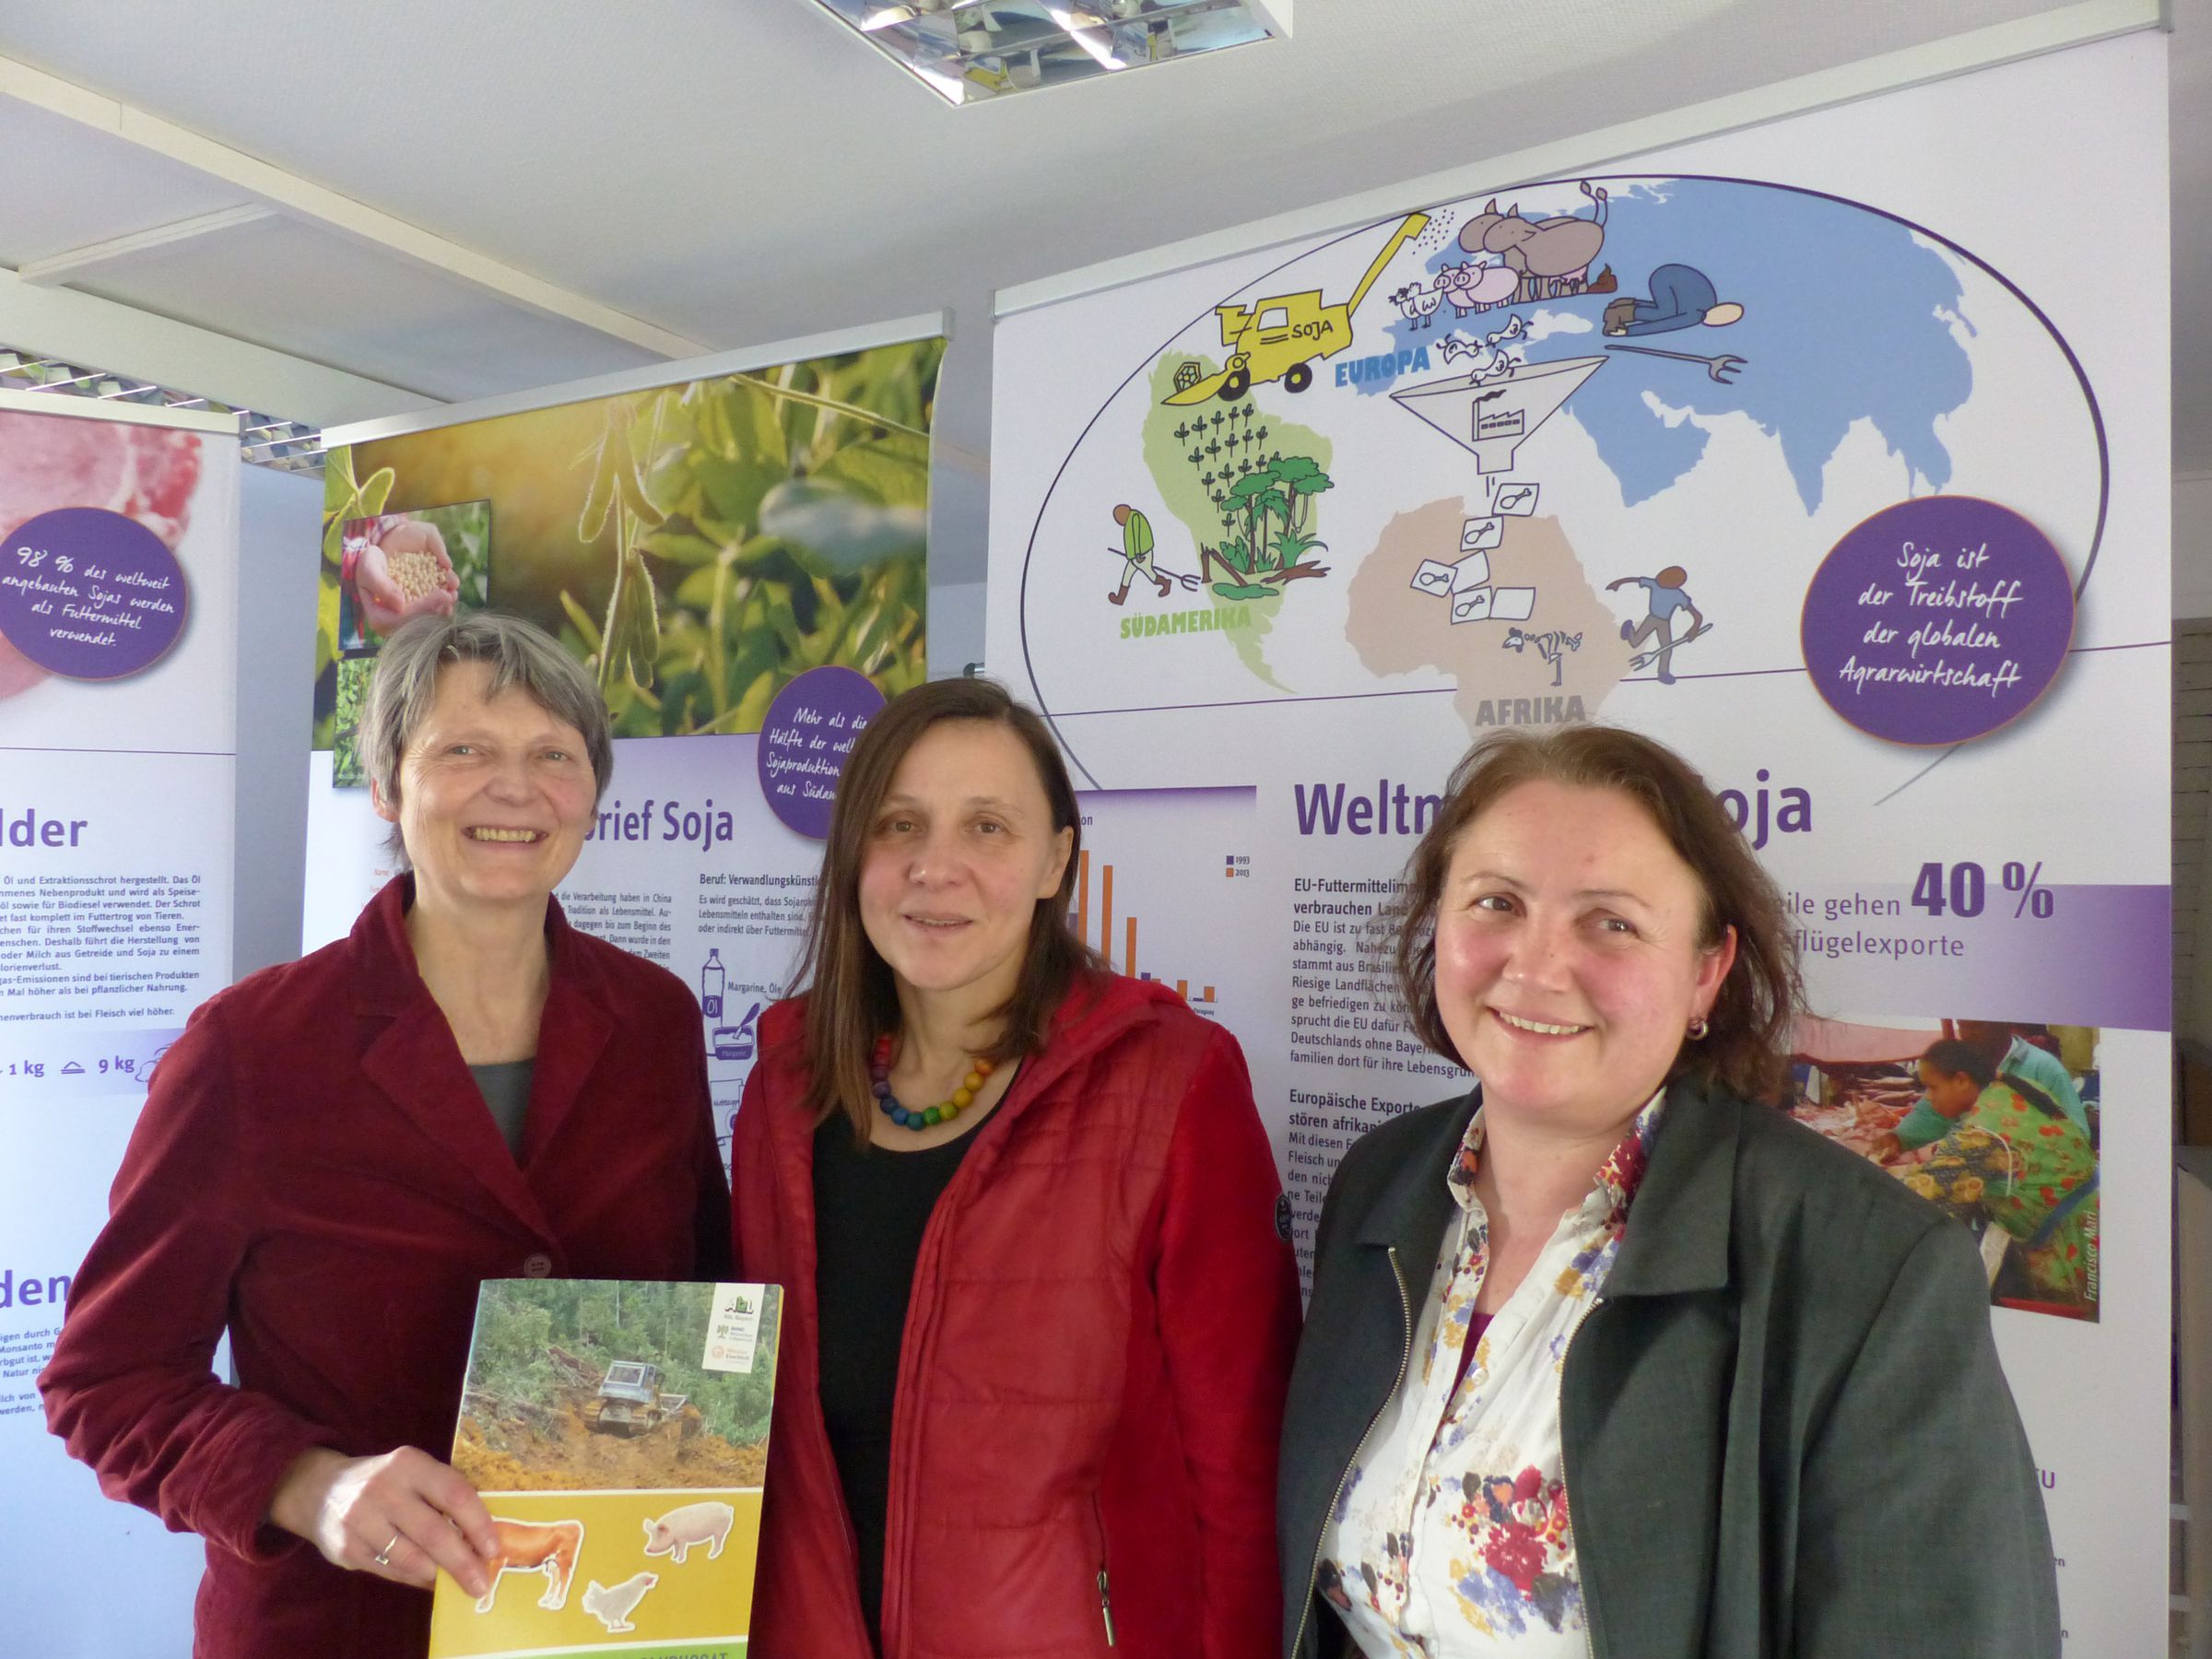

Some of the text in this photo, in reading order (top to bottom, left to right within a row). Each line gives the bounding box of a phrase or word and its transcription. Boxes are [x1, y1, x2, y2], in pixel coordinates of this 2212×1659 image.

[1291, 321, 1334, 340] SOJA
[1335, 346, 1431, 388] EUROPA
[18, 547, 170, 590] 98 % des weltweit
[1897, 542, 1990, 584] Soja ist
[2, 576, 174, 614] angebauten Sojas werden
[1858, 580, 2024, 618] der Treibstoff
[31, 601, 142, 629] als Futtermittel
[1120, 606, 1251, 640] SÜDAMERIKA
[50, 629, 116, 646] verwendet.
[1864, 619, 2001, 659] der globalen
[1840, 655, 2022, 698] Agrarwirtschaft
[794, 708, 822, 724] Mehr
[830, 716, 845, 728] als
[1476, 695, 1586, 726] AFRIKA
[770, 729, 827, 752] Hälfte der
[777, 783, 796, 795] aus
[663, 799, 734, 853] Soja
[1236, 855, 1251, 865] 1993
[18, 877, 36, 885] und
[40, 876, 117, 885] Extraktionsschrot
[173, 876, 189, 884] Das
[192, 875, 201, 884] Öl
[700, 874, 726, 885] Beruf:
[1235, 869, 1250, 878] 2013
[40, 888, 105, 899] Nebenprodukt
[620, 893, 640, 901] haben
[653, 893, 671, 903] China
[1825, 894, 1901, 922] gehen
[1911, 862, 1986, 917] 40
[2002, 860, 2054, 919] %
[42, 900, 55, 909] für
[59, 900, 100, 909] Biodiesel
[700, 895, 707, 904] Es
[710, 895, 726, 904] wird
[765, 896, 782, 906] dass
[1294, 900, 1372, 916] verbrauchen
[30, 913, 71, 923] komplett
[88, 912, 133, 923] Futtertrog
[750, 911, 784, 921] enthalten
[28, 925, 41, 934] für
[76, 924, 134, 933] Stoffwechsel
[660, 922, 671, 931] des
[699, 924, 715, 933] oder
[717, 924, 744, 934] indirekt
[747, 925, 763, 935] über
[1294, 922, 1361, 935] Die EU ist zu
[111, 936, 124, 945] die
[128, 936, 179, 945] Herstellung
[658, 935, 671, 946] den
[1293, 940, 1347, 955] abhängig.
[27, 950, 52, 959] Milch
[75, 948, 113, 958] Getreide
[137, 948, 156, 958] Soja
[1293, 959, 1354, 971] stammt aus
[72, 971, 199, 982] sind bei tierischen Produkten
[1292, 976, 1331, 992] Riesige
[92, 984, 144, 995] pflanzlicher
[1292, 995, 1369, 1013] ge befriedigen
[78, 1010, 92, 1018] bei
[96, 1009, 126, 1018] Fleisch
[129, 1008, 144, 1017] viel
[1291, 1015, 1331, 1030] sprucht
[1334, 1016, 1350, 1029] die
[1354, 1017, 1368, 1030] EU
[1291, 1031, 1392, 1052] Deutschlands ohne
[99, 1055, 135, 1074] 9 kg
[1290, 1050, 1404, 1072] familien dort für ihre
[9, 1061, 44, 1077] 1 kg
[1290, 1088, 1366, 1110] Europäische
[1289, 1112, 1328, 1127] stören
[1289, 1132, 1343, 1149] Mit diesen
[1288, 1151, 1324, 1166] Fleisch
[1288, 1170, 1307, 1182] den
[2084, 1211, 2097, 1301] Francisco Mari
